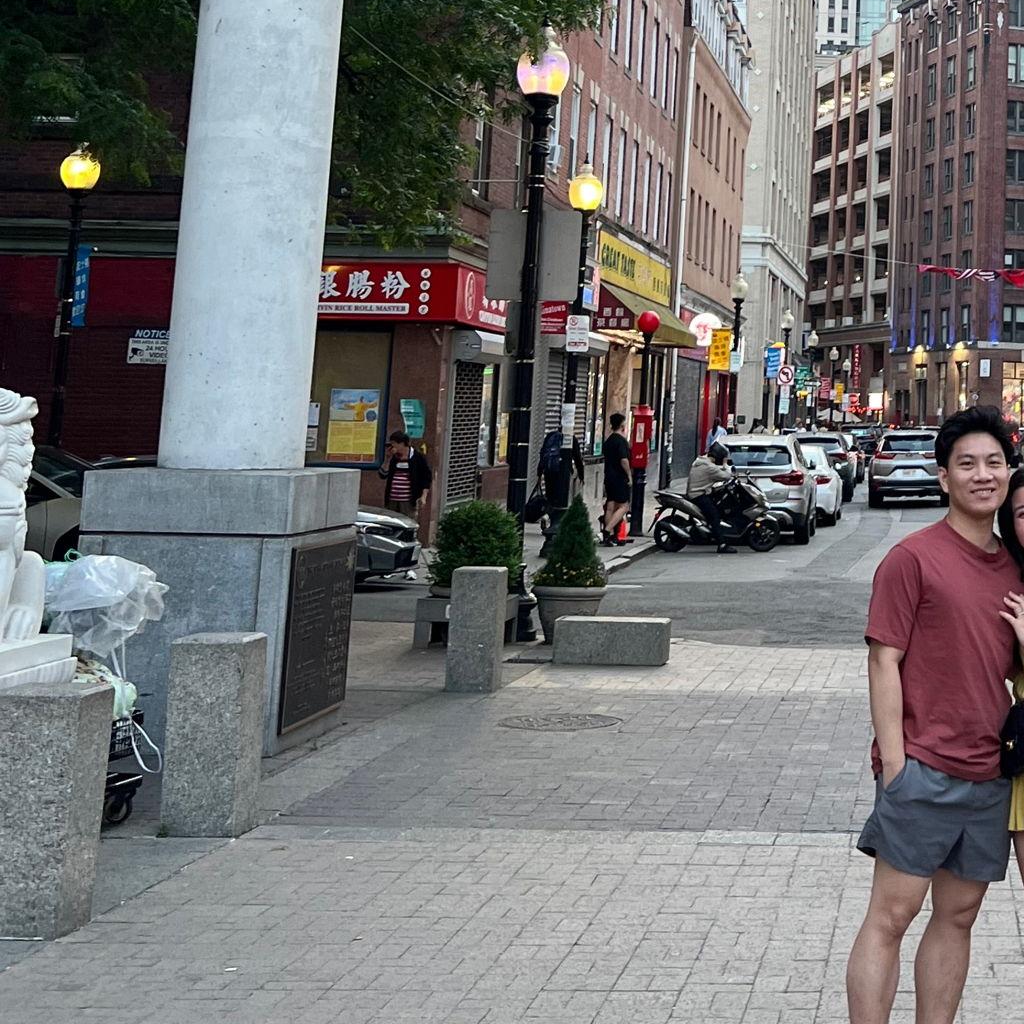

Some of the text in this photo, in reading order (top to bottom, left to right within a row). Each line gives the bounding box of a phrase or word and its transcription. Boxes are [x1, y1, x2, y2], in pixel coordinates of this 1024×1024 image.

[334, 304, 352, 312] RICE
[354, 304, 374, 312] ROLL
[134, 329, 171, 338] NOTICE
